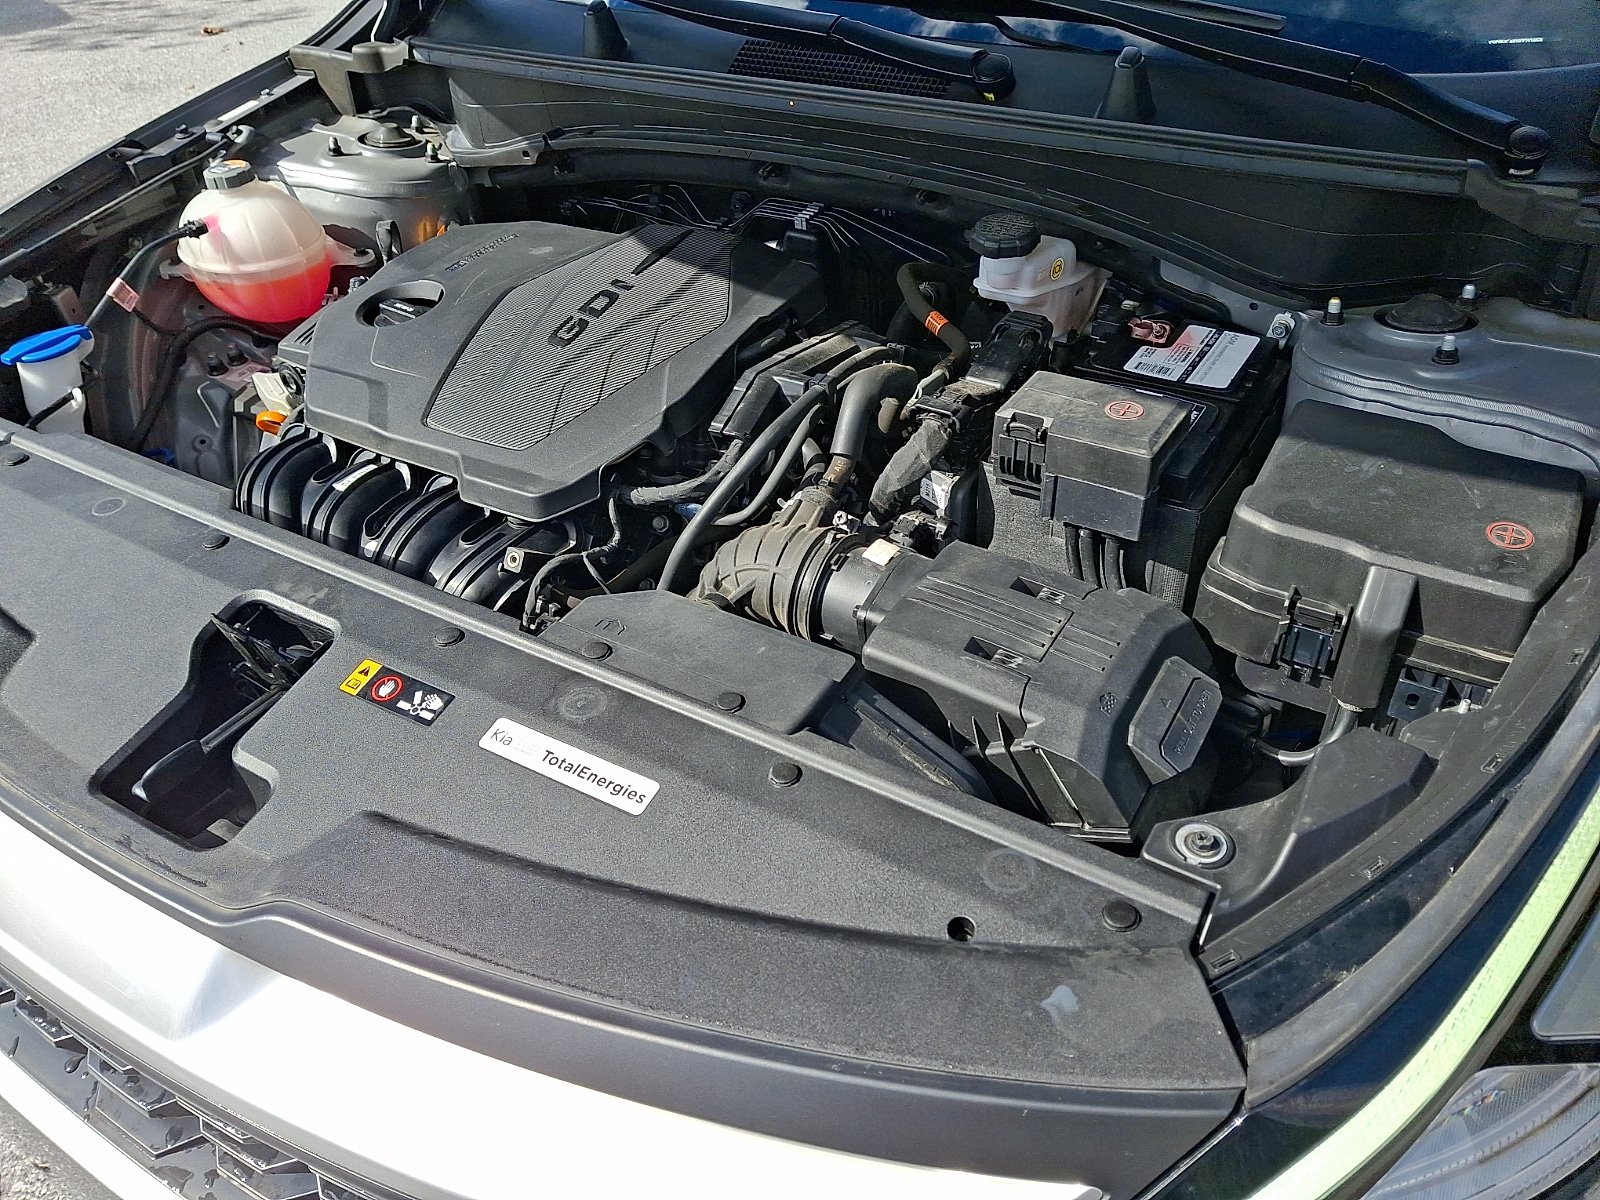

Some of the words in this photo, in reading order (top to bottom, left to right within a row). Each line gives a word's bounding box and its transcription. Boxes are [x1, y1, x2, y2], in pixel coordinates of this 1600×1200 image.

[548, 279, 635, 349] GDI
[490, 728, 513, 746] Kia
[541, 749, 648, 804] TotalEnergies
